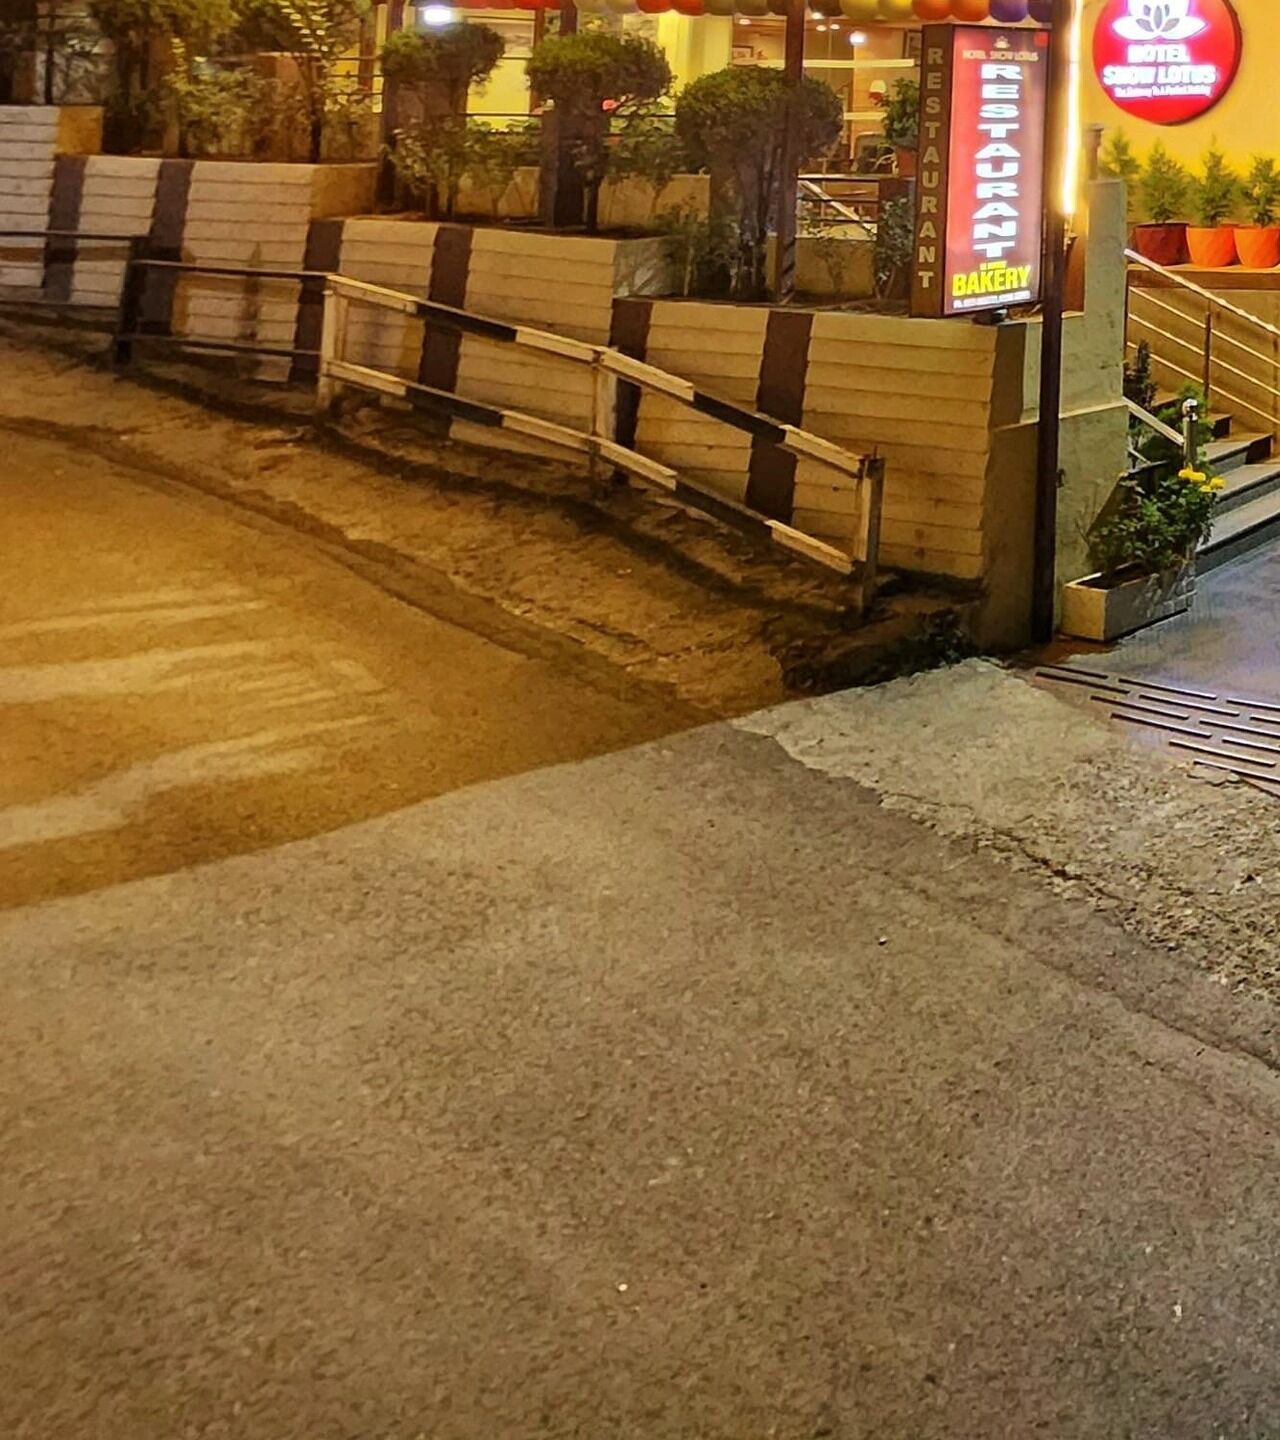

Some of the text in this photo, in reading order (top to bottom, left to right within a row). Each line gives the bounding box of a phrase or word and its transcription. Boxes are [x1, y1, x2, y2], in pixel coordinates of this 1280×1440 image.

[919, 47, 943, 288] RESTAURANT
[972, 63, 1023, 258] RESTAURANT
[952, 264, 1031, 296] BAKERY
